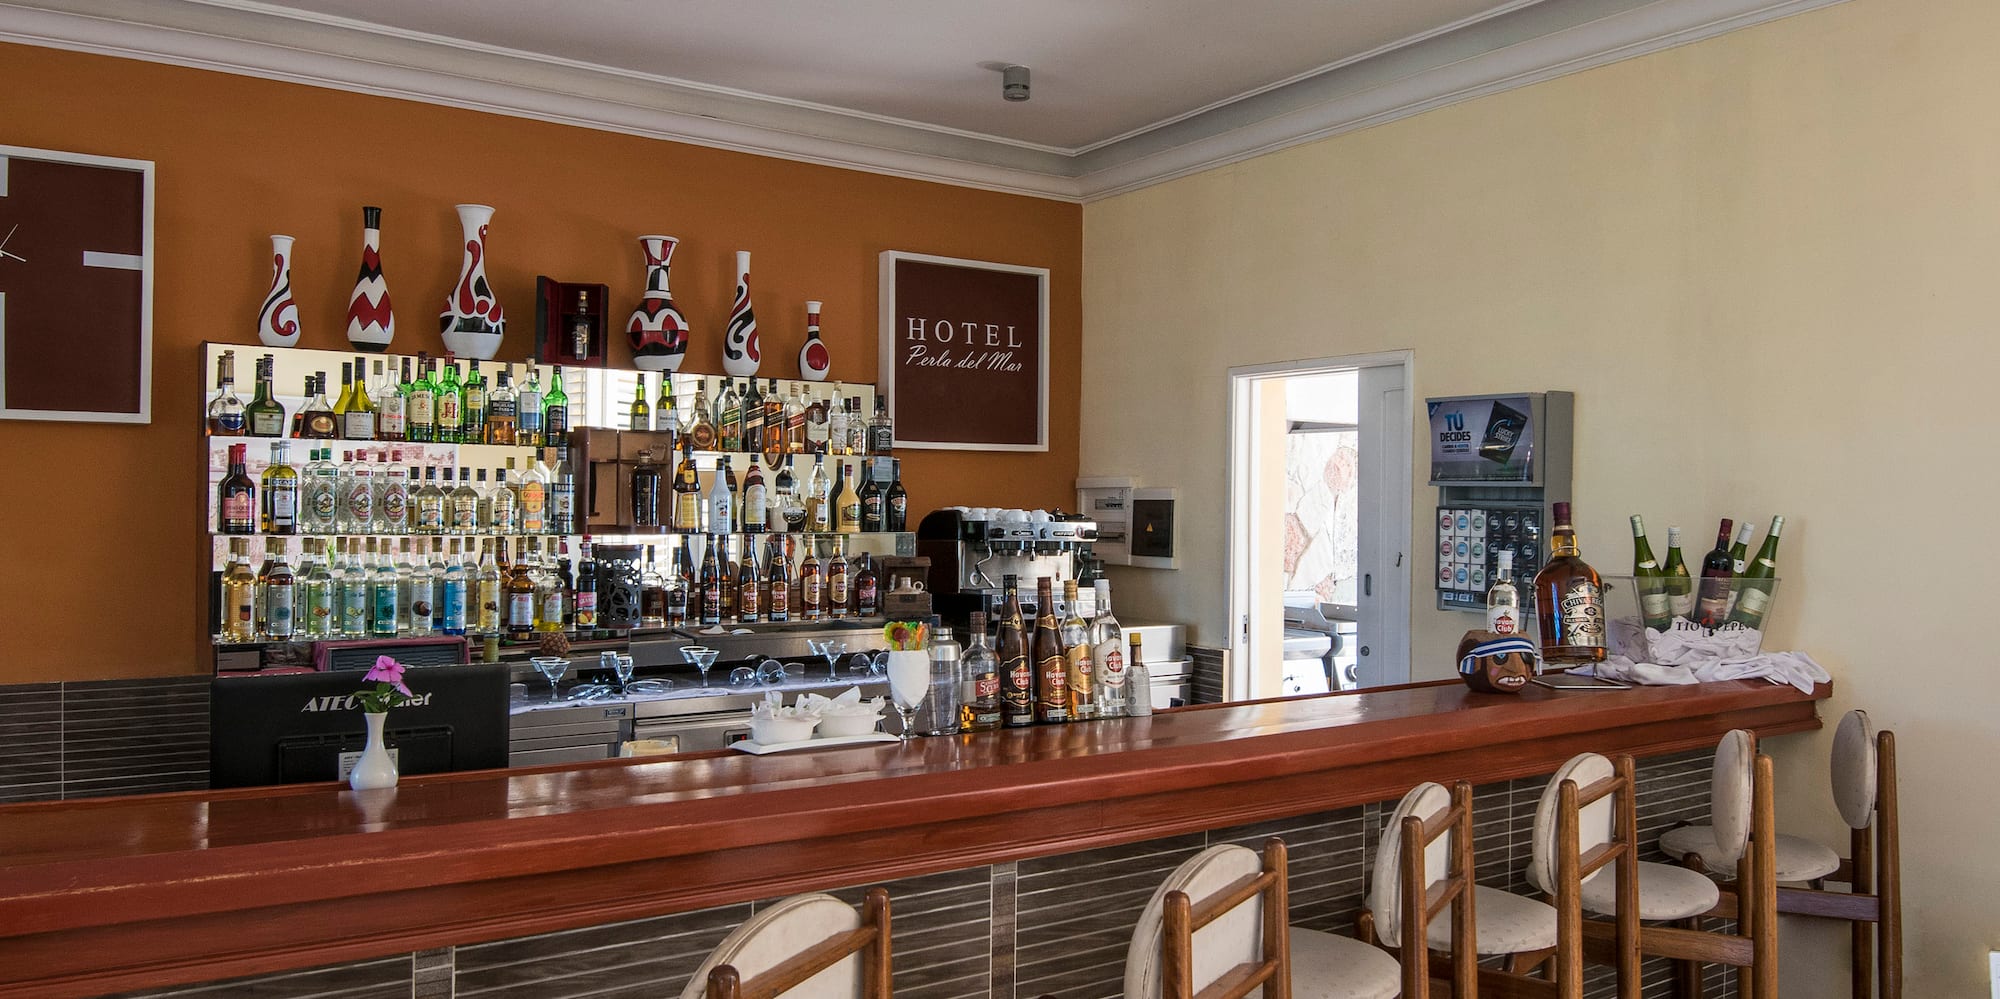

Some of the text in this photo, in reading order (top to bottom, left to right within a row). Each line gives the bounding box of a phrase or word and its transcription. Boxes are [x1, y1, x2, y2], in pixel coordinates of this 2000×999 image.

[906, 317, 1022, 348] HOTEL
[906, 344, 1023, 372] Perla del Mar
[1444, 410, 1464, 431] TÚ
[1440, 431, 1472, 442] DECIDES
[1497, 624, 1512, 633] Club
[1676, 621, 1700, 631] TIO
[301, 695, 358, 712] ATEC
